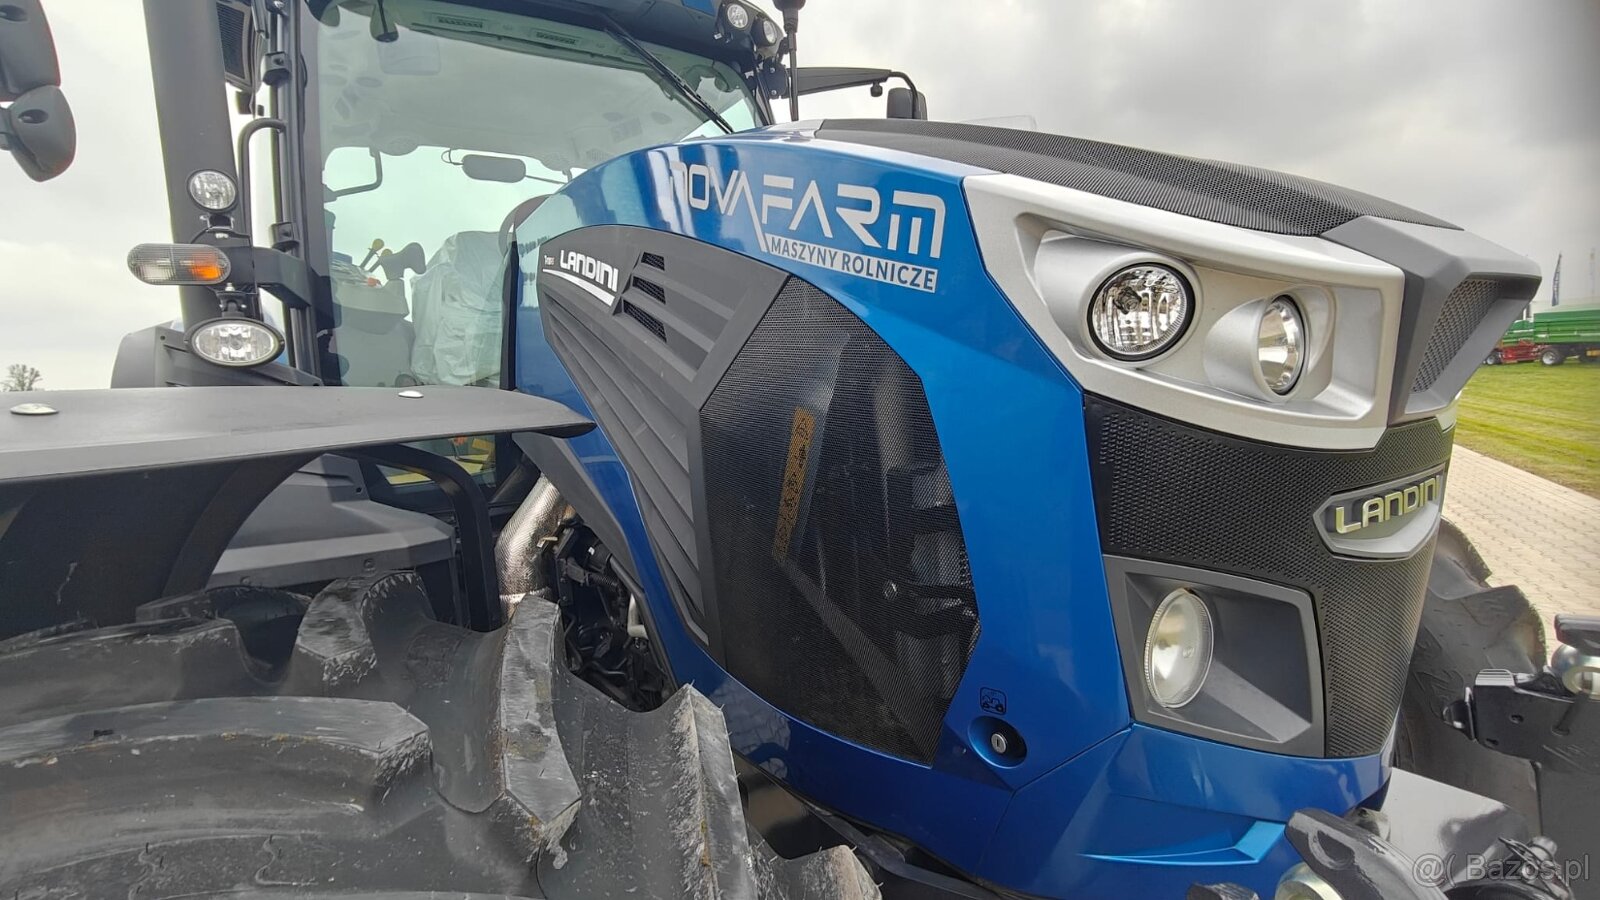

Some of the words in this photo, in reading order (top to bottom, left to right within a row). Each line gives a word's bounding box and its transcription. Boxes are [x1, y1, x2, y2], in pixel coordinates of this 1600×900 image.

[560, 249, 619, 292] LANDINI
[771, 236, 838, 270] MASZYNY
[841, 254, 935, 291] ROLNICZE
[1336, 475, 1440, 534] LANDINI
